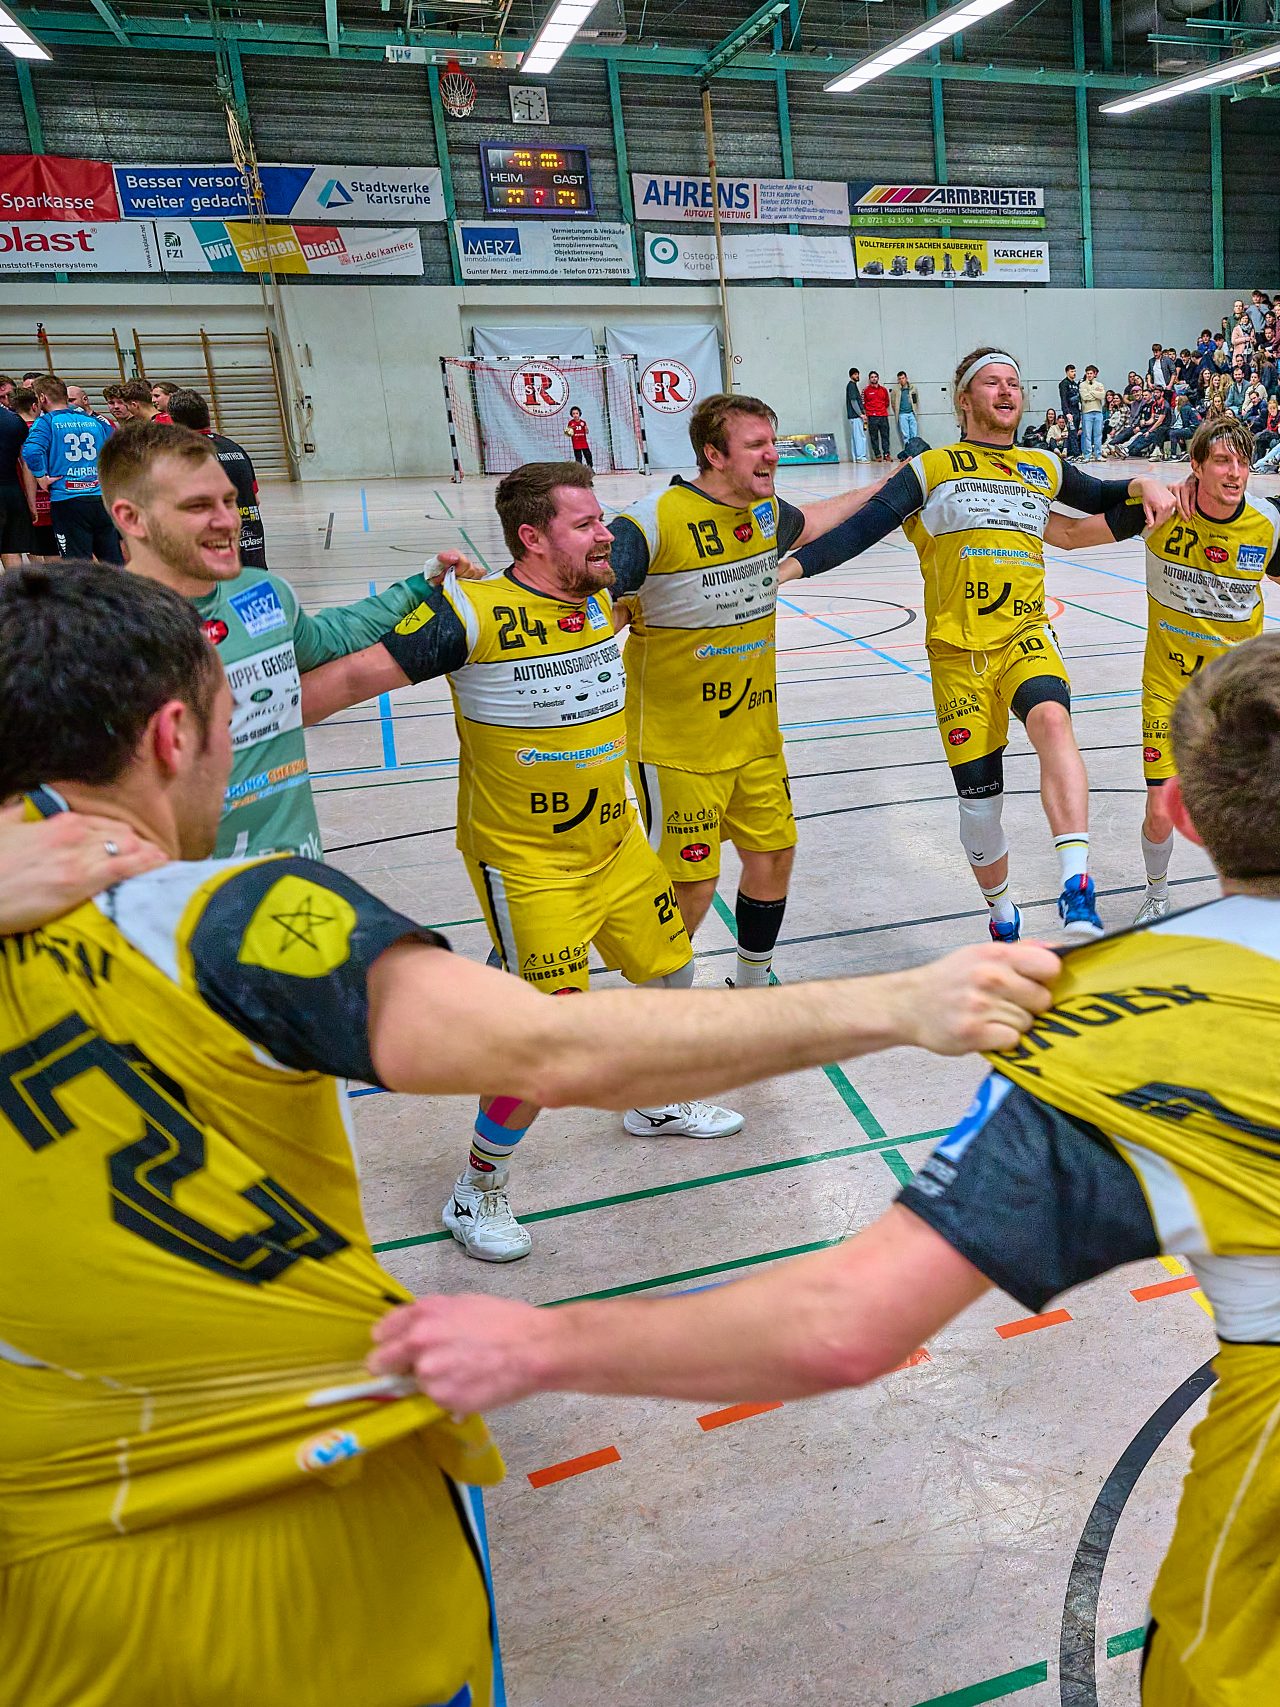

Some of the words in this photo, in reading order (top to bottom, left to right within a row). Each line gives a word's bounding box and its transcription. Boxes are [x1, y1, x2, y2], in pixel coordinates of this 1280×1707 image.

[126, 175, 183, 188] Besser
[490, 172, 524, 182] HEIM
[553, 174, 585, 185] GAST
[351, 181, 430, 193] Stadtwerke
[642, 179, 750, 210] AHRENS
[2, 192, 94, 212] Sparkasse
[131, 194, 185, 209] weiter
[367, 193, 431, 205] Karlsruhe
[925, 188, 1037, 206] ARMBRUSTER
[684, 209, 751, 219] AUTOVEMIETUNG
[919, 207, 956, 216] Wintergärten
[1002, 208, 1038, 216] Glasfassaden
[204, 243, 233, 261] Wir
[241, 239, 296, 262] suchen
[303, 238, 344, 260] Dich!
[351, 241, 414, 264] fzi.de/karriere
[467, 240, 516, 256] MERZ
[859, 240, 905, 250] VOLLTREFFER
[914, 242, 942, 250] SACHEN
[942, 242, 983, 251] SAUBERKEIT
[166, 250, 183, 258] FZI
[993, 249, 1043, 259] KÄRCHER
[466, 268, 490, 276] Gunter
[684, 262, 714, 271] Kurbel
[63, 432, 97, 461] 33
[944, 449, 978, 473] 10
[954, 482, 1031, 498] AUTOHAUSGRUPPE
[239, 537, 263, 548] uplast
[686, 519, 725, 559] 13
[1164, 525, 1199, 559] 27
[1238, 551, 1265, 565] MERZ
[703, 588, 745, 600] VOLVO
[965, 581, 989, 599] BB
[493, 605, 548, 651] 24
[1018, 637, 1045, 656] 10
[513, 650, 602, 682] AUTOHAUSGRUPPE
[516, 684, 572, 695] VOLVO
[702, 682, 732, 702] BB
[532, 698, 566, 709] Polestar
[531, 791, 570, 815] BB
[666, 825, 700, 835] Fitness
[523, 964, 566, 983] Fitness
